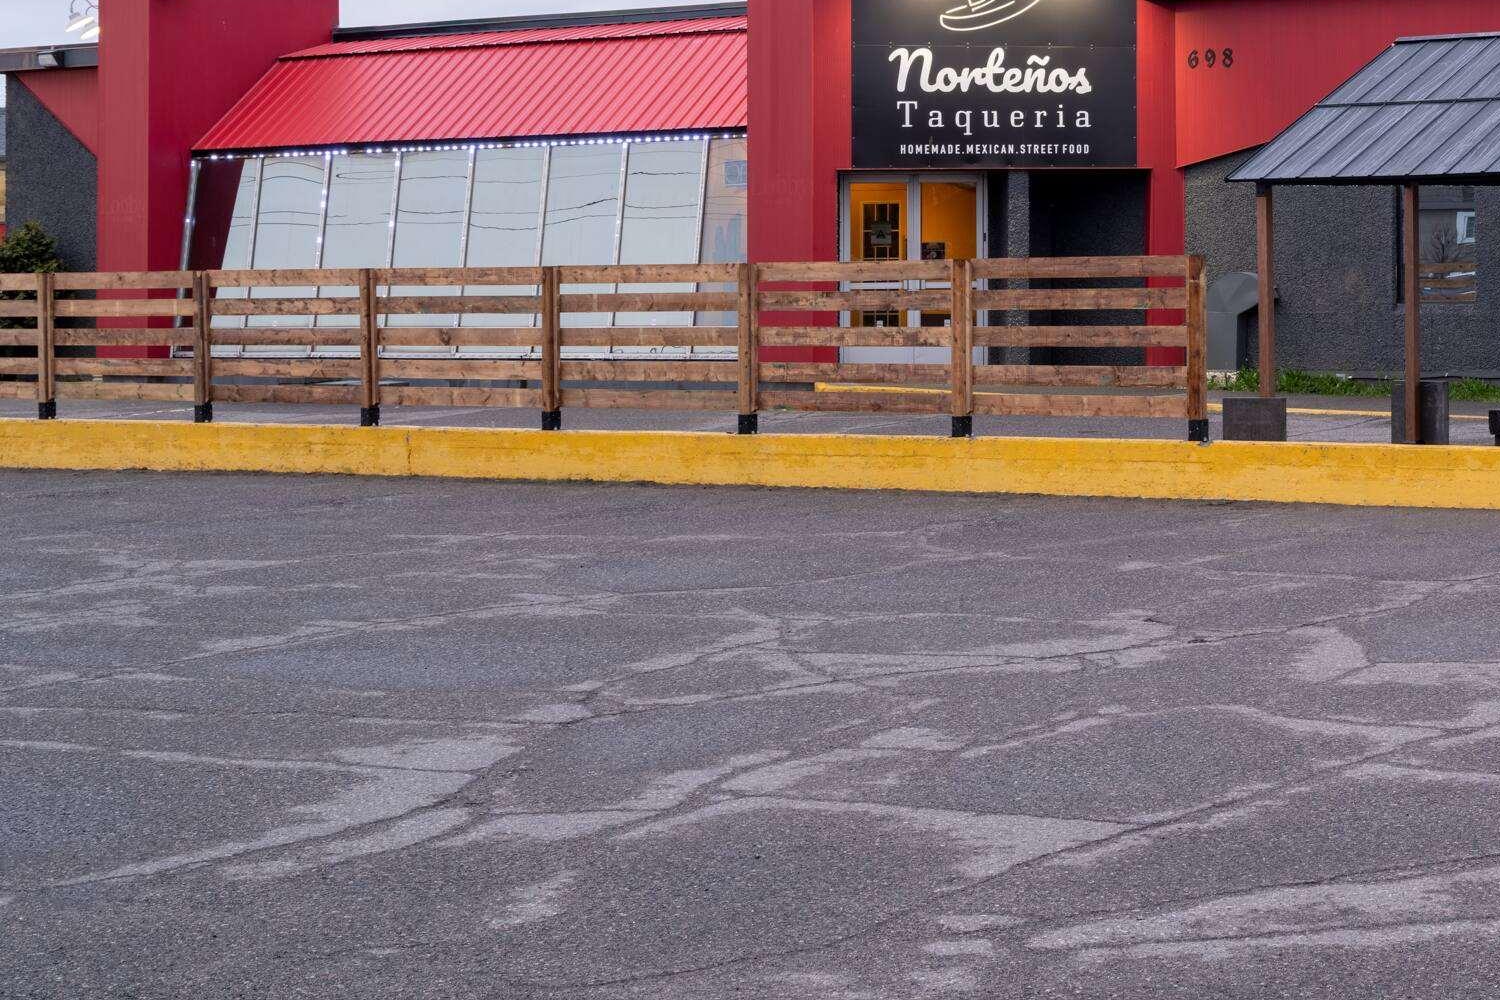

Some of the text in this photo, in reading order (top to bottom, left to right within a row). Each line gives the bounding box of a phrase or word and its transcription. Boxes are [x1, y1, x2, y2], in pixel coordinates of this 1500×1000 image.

[888, 47, 1092, 94] Norteños
[1187, 48, 1234, 70] 698
[896, 100, 1092, 136] Taqueria
[1062, 144, 1090, 155] FOOD
